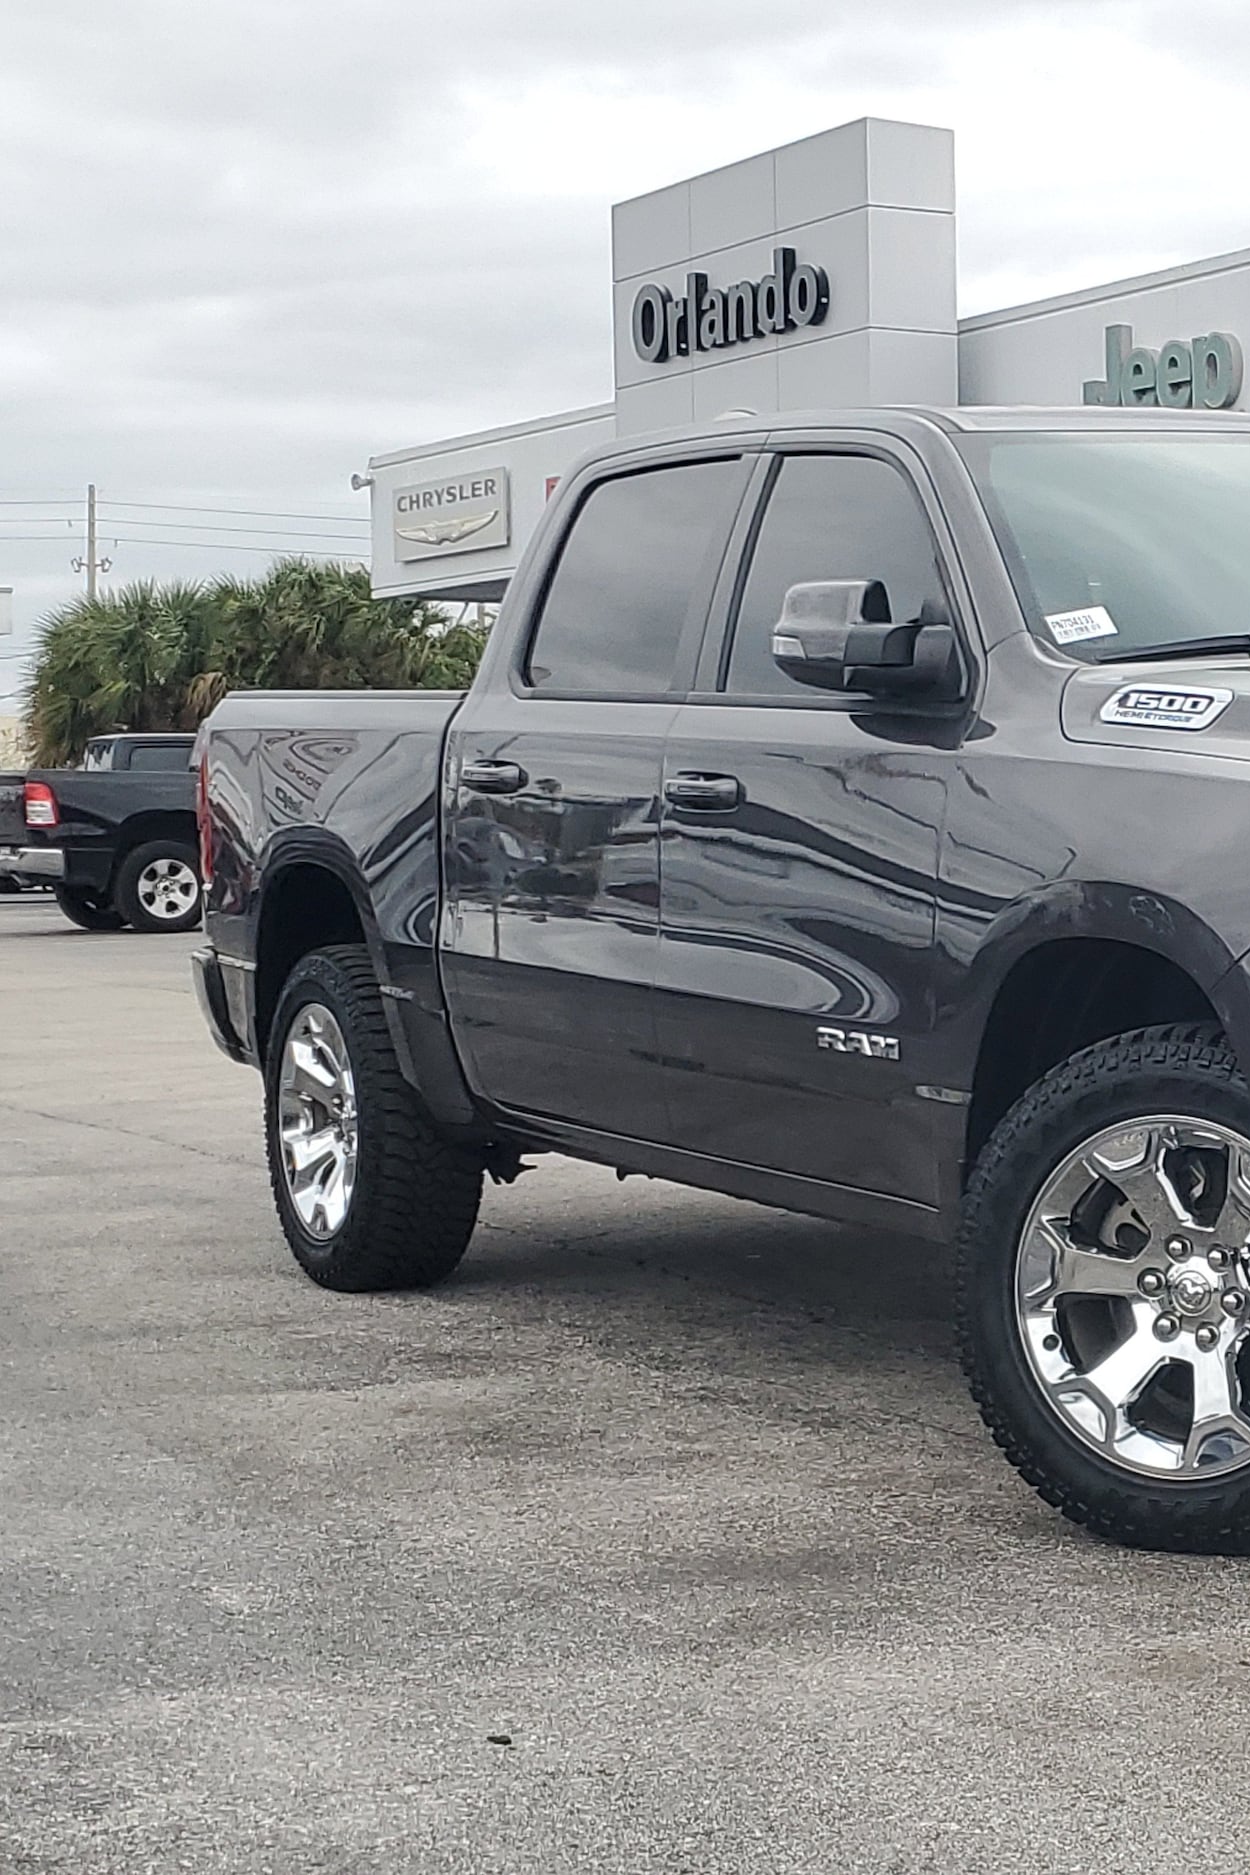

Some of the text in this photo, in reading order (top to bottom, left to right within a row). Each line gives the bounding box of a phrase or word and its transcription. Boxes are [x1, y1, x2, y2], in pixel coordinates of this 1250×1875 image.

[632, 247, 829, 362] Orlando
[1083, 324, 1243, 409] Jeep
[397, 478, 497, 513] CHRYSLER
[1114, 709, 1144, 719] HEMI
[1125, 692, 1211, 713] 1500
[816, 1026, 900, 1061] RAM
